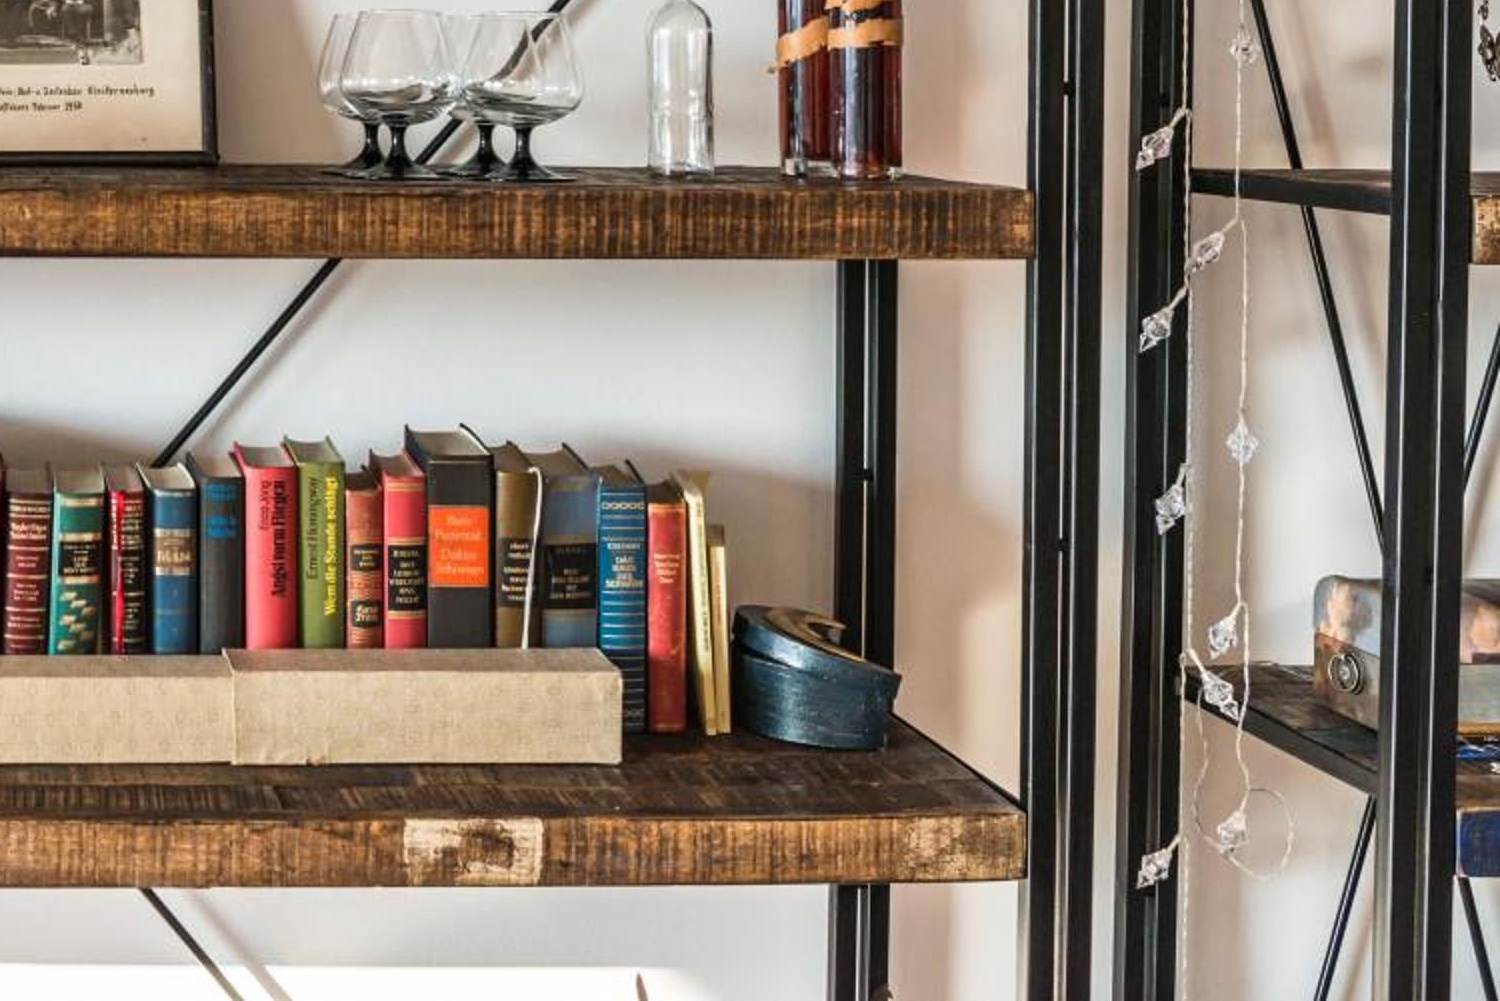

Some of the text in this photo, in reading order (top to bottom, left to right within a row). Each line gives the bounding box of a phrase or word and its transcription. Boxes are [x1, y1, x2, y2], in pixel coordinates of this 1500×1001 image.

[270, 480, 288, 526] Fliegen
[305, 477, 321, 580] Ernest Hemingway
[271, 562, 288, 599] Angst
[324, 475, 339, 616] Wem die Stunde schlägt
